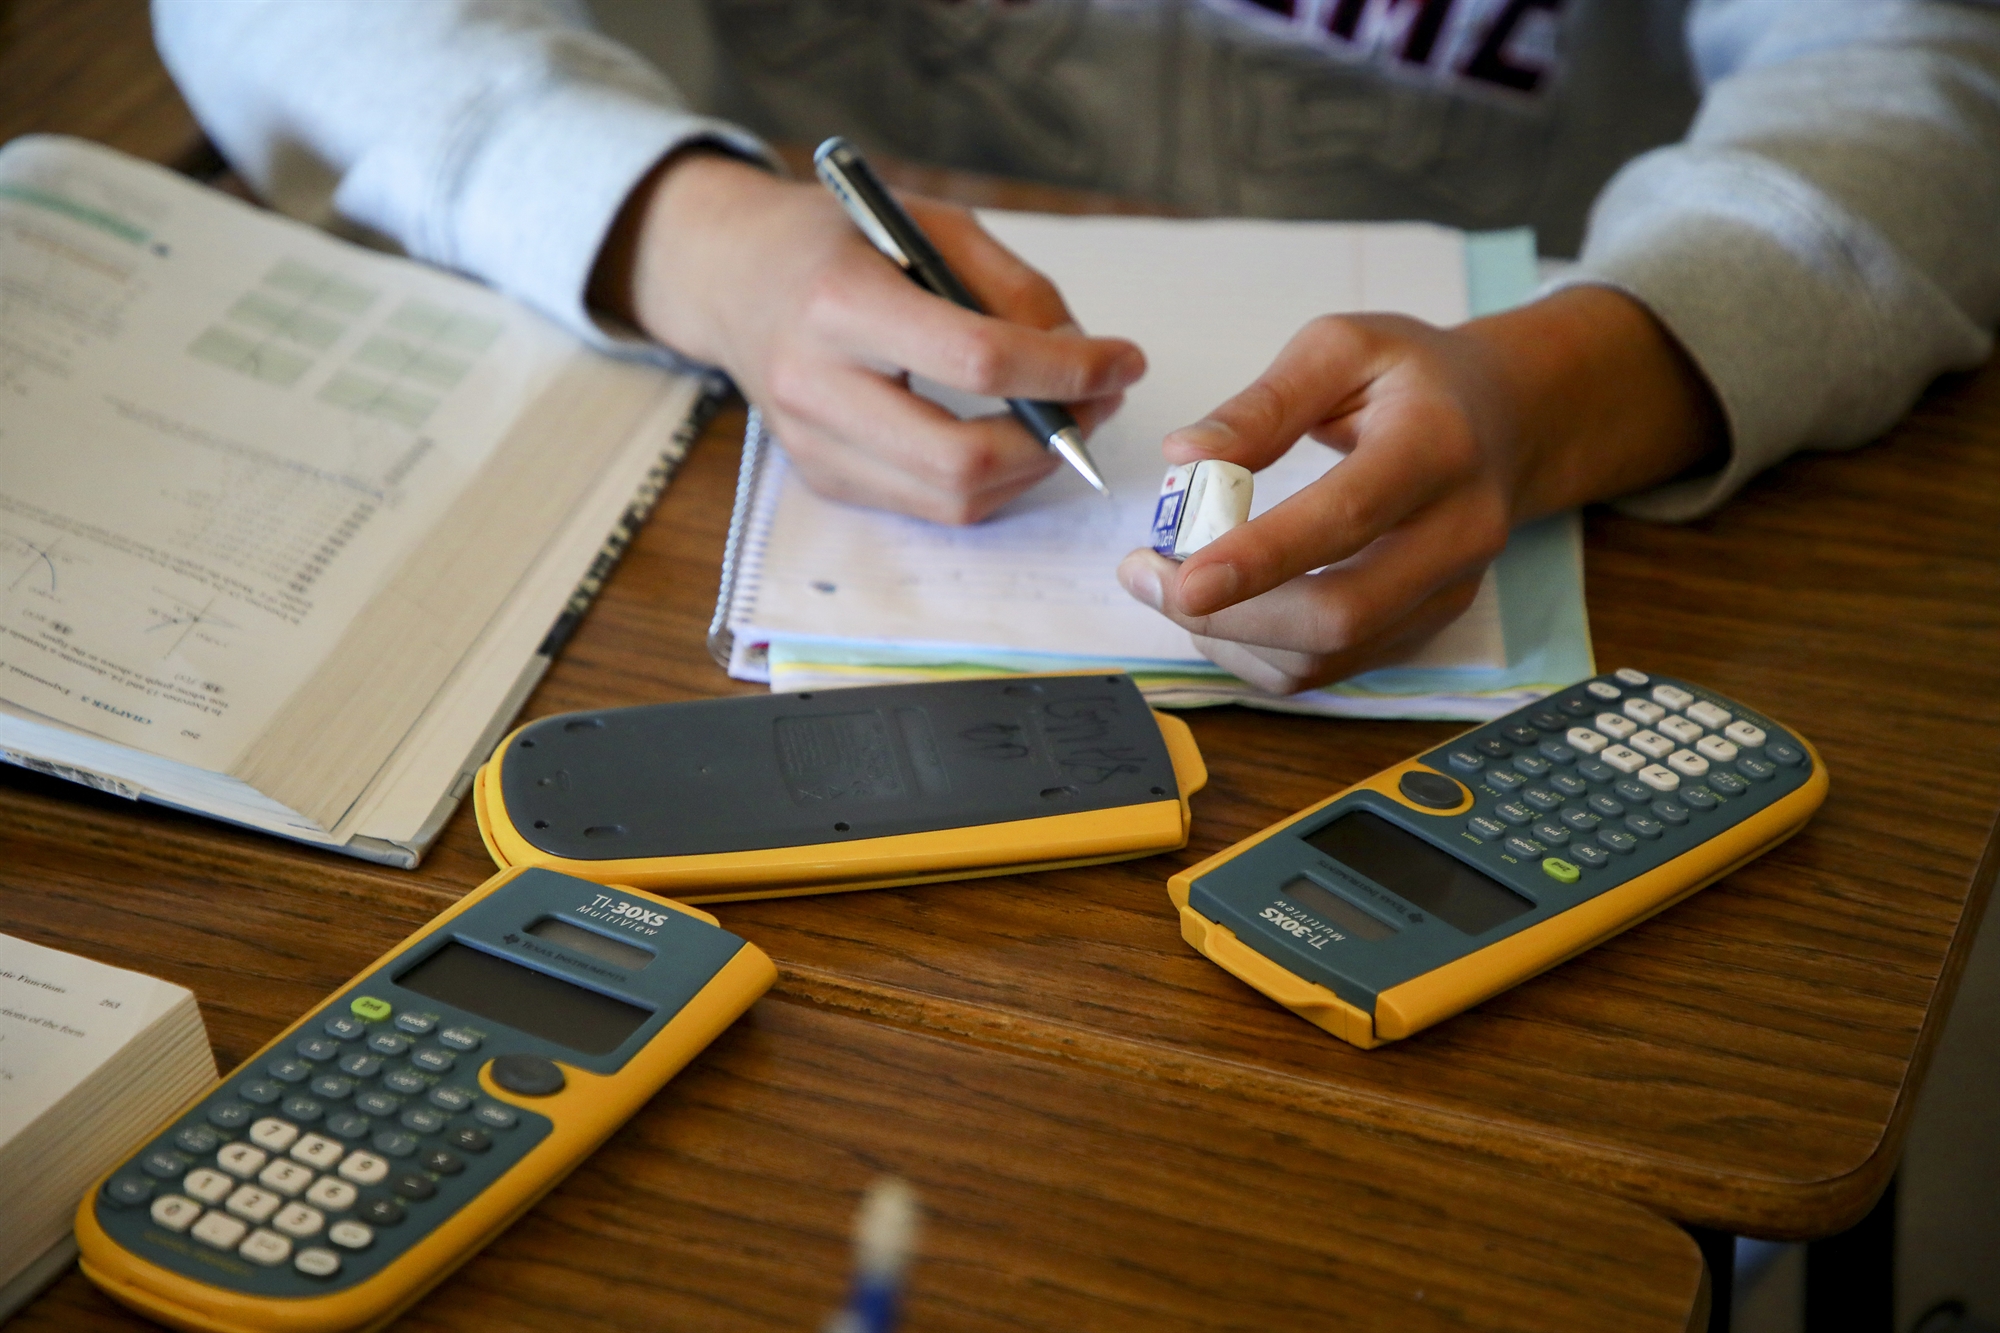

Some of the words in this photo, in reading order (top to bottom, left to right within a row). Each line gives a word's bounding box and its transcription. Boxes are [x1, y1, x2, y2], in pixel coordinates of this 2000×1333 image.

[91, 700, 152, 724] CHAPTER
[1743, 727, 1757, 736] 0
[1456, 752, 1478, 764] clear
[1618, 751, 1634, 760] 8
[1494, 771, 1515, 783] table
[1561, 777, 1576, 786] cos
[1652, 772, 1669, 780] 7
[1505, 805, 1524, 816] data
[1474, 817, 1500, 832] delete
[1543, 826, 1561, 836] prb
[1460, 832, 1483, 846] insert
[1511, 838, 1537, 852] mode
[1582, 847, 1597, 857] log
[1501, 854, 1518, 864] quit
[1551, 861, 1571, 872] 2nd
[591, 893, 668, 927] TI-30XS
[576, 904, 658, 936] MultiView
[1273, 900, 1346, 942] MultiView
[1258, 907, 1330, 951] TI-30XS
[17, 975, 66, 993] Functions
[99, 999, 121, 1010] 263
[361, 1001, 383, 1011] 2nd
[335, 1020, 352, 1032] log
[400, 1013, 428, 1028] mode
[42, 1021, 59, 1030] the
[59, 1026, 86, 1038] form
[376, 1037, 396, 1047] prb
[443, 1029, 472, 1045] delete
[264, 1125, 281, 1137] 7
[308, 1143, 326, 1156] 8
[231, 1151, 248, 1162] 4
[358, 1160, 374, 1172] 9
[276, 1168, 294, 1181] 5
[324, 1186, 342, 1199] 6
[244, 1194, 262, 1209] 2
[164, 1203, 182, 1218] 0
[291, 1212, 309, 1226] 3
